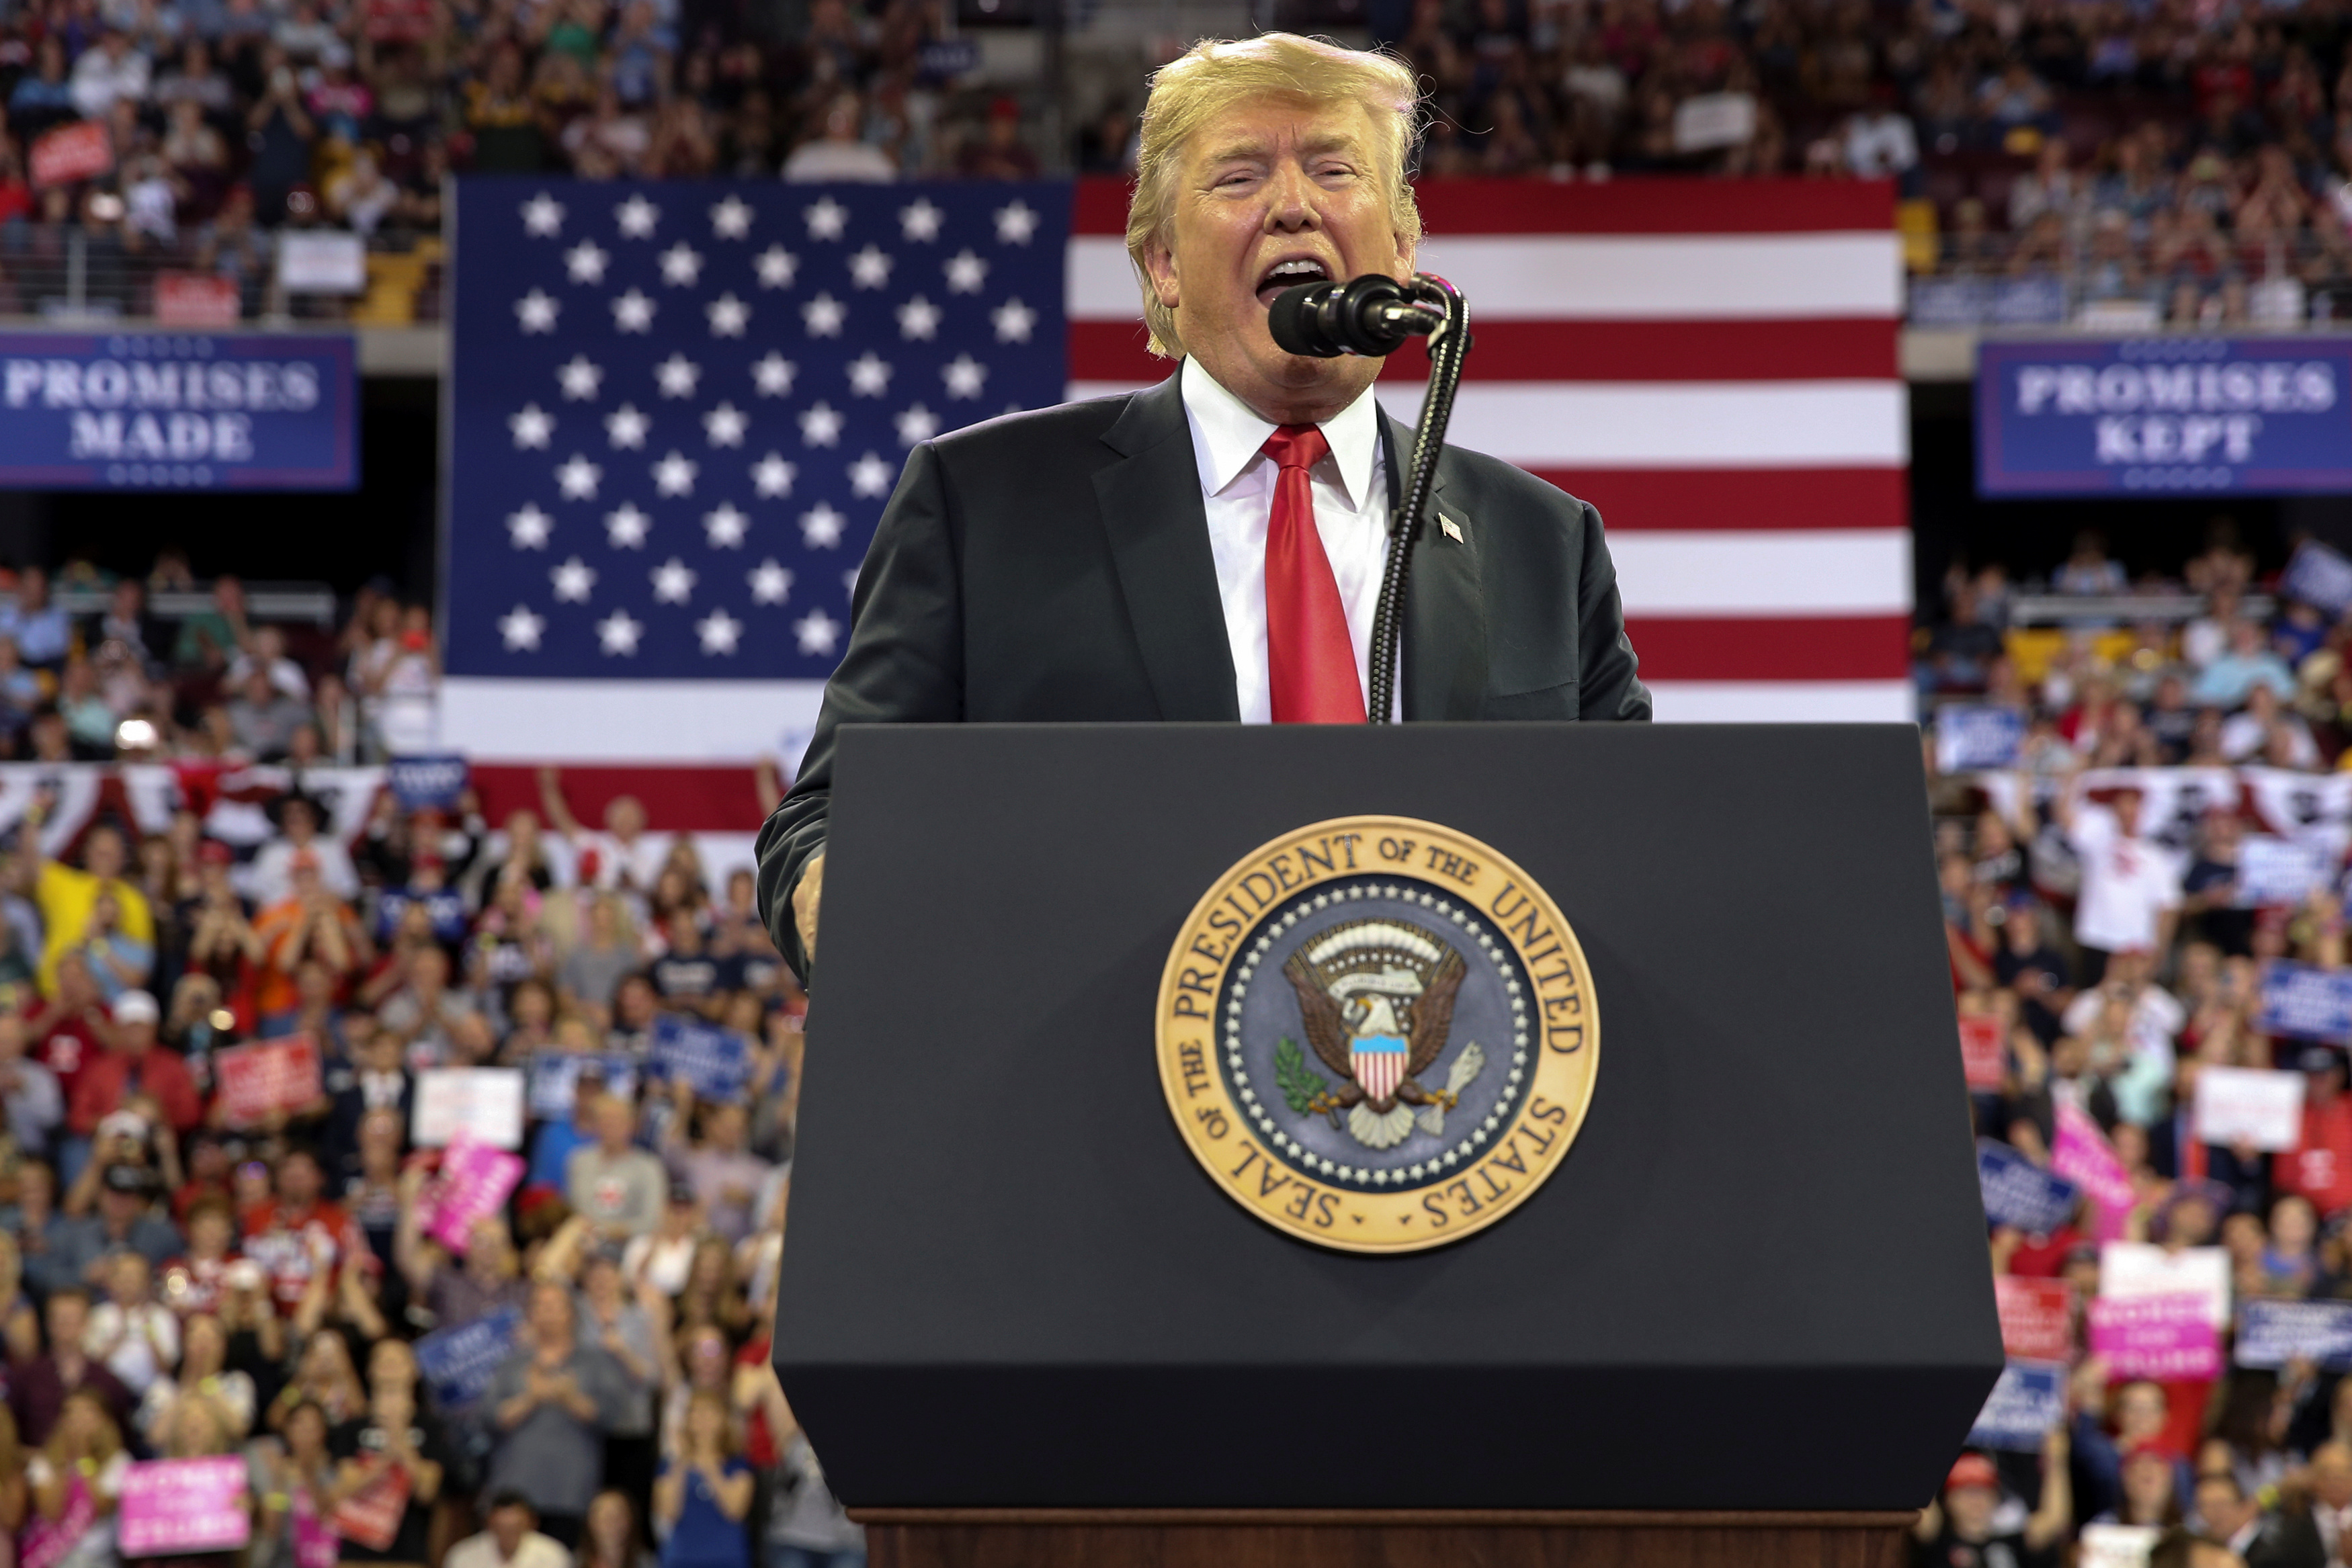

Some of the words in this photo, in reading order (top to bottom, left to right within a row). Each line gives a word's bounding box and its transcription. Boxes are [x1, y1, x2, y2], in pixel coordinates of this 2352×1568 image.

[4, 359, 320, 412] PROMISES
[2018, 361, 2337, 414] PROMISES
[71, 411, 254, 462] MADE
[2097, 414, 2263, 464] KEPT
[1378, 837, 1415, 862] OF
[1425, 846, 1480, 886] THE
[1174, 834, 1362, 1020] PRESIDENT
[1490, 881, 1583, 1055] UNITED
[1179, 1039, 1210, 1098] THE
[1195, 1107, 1230, 1139] OF
[1231, 1141, 1341, 1228] SEAL
[1422, 1096, 1567, 1228] STATES
